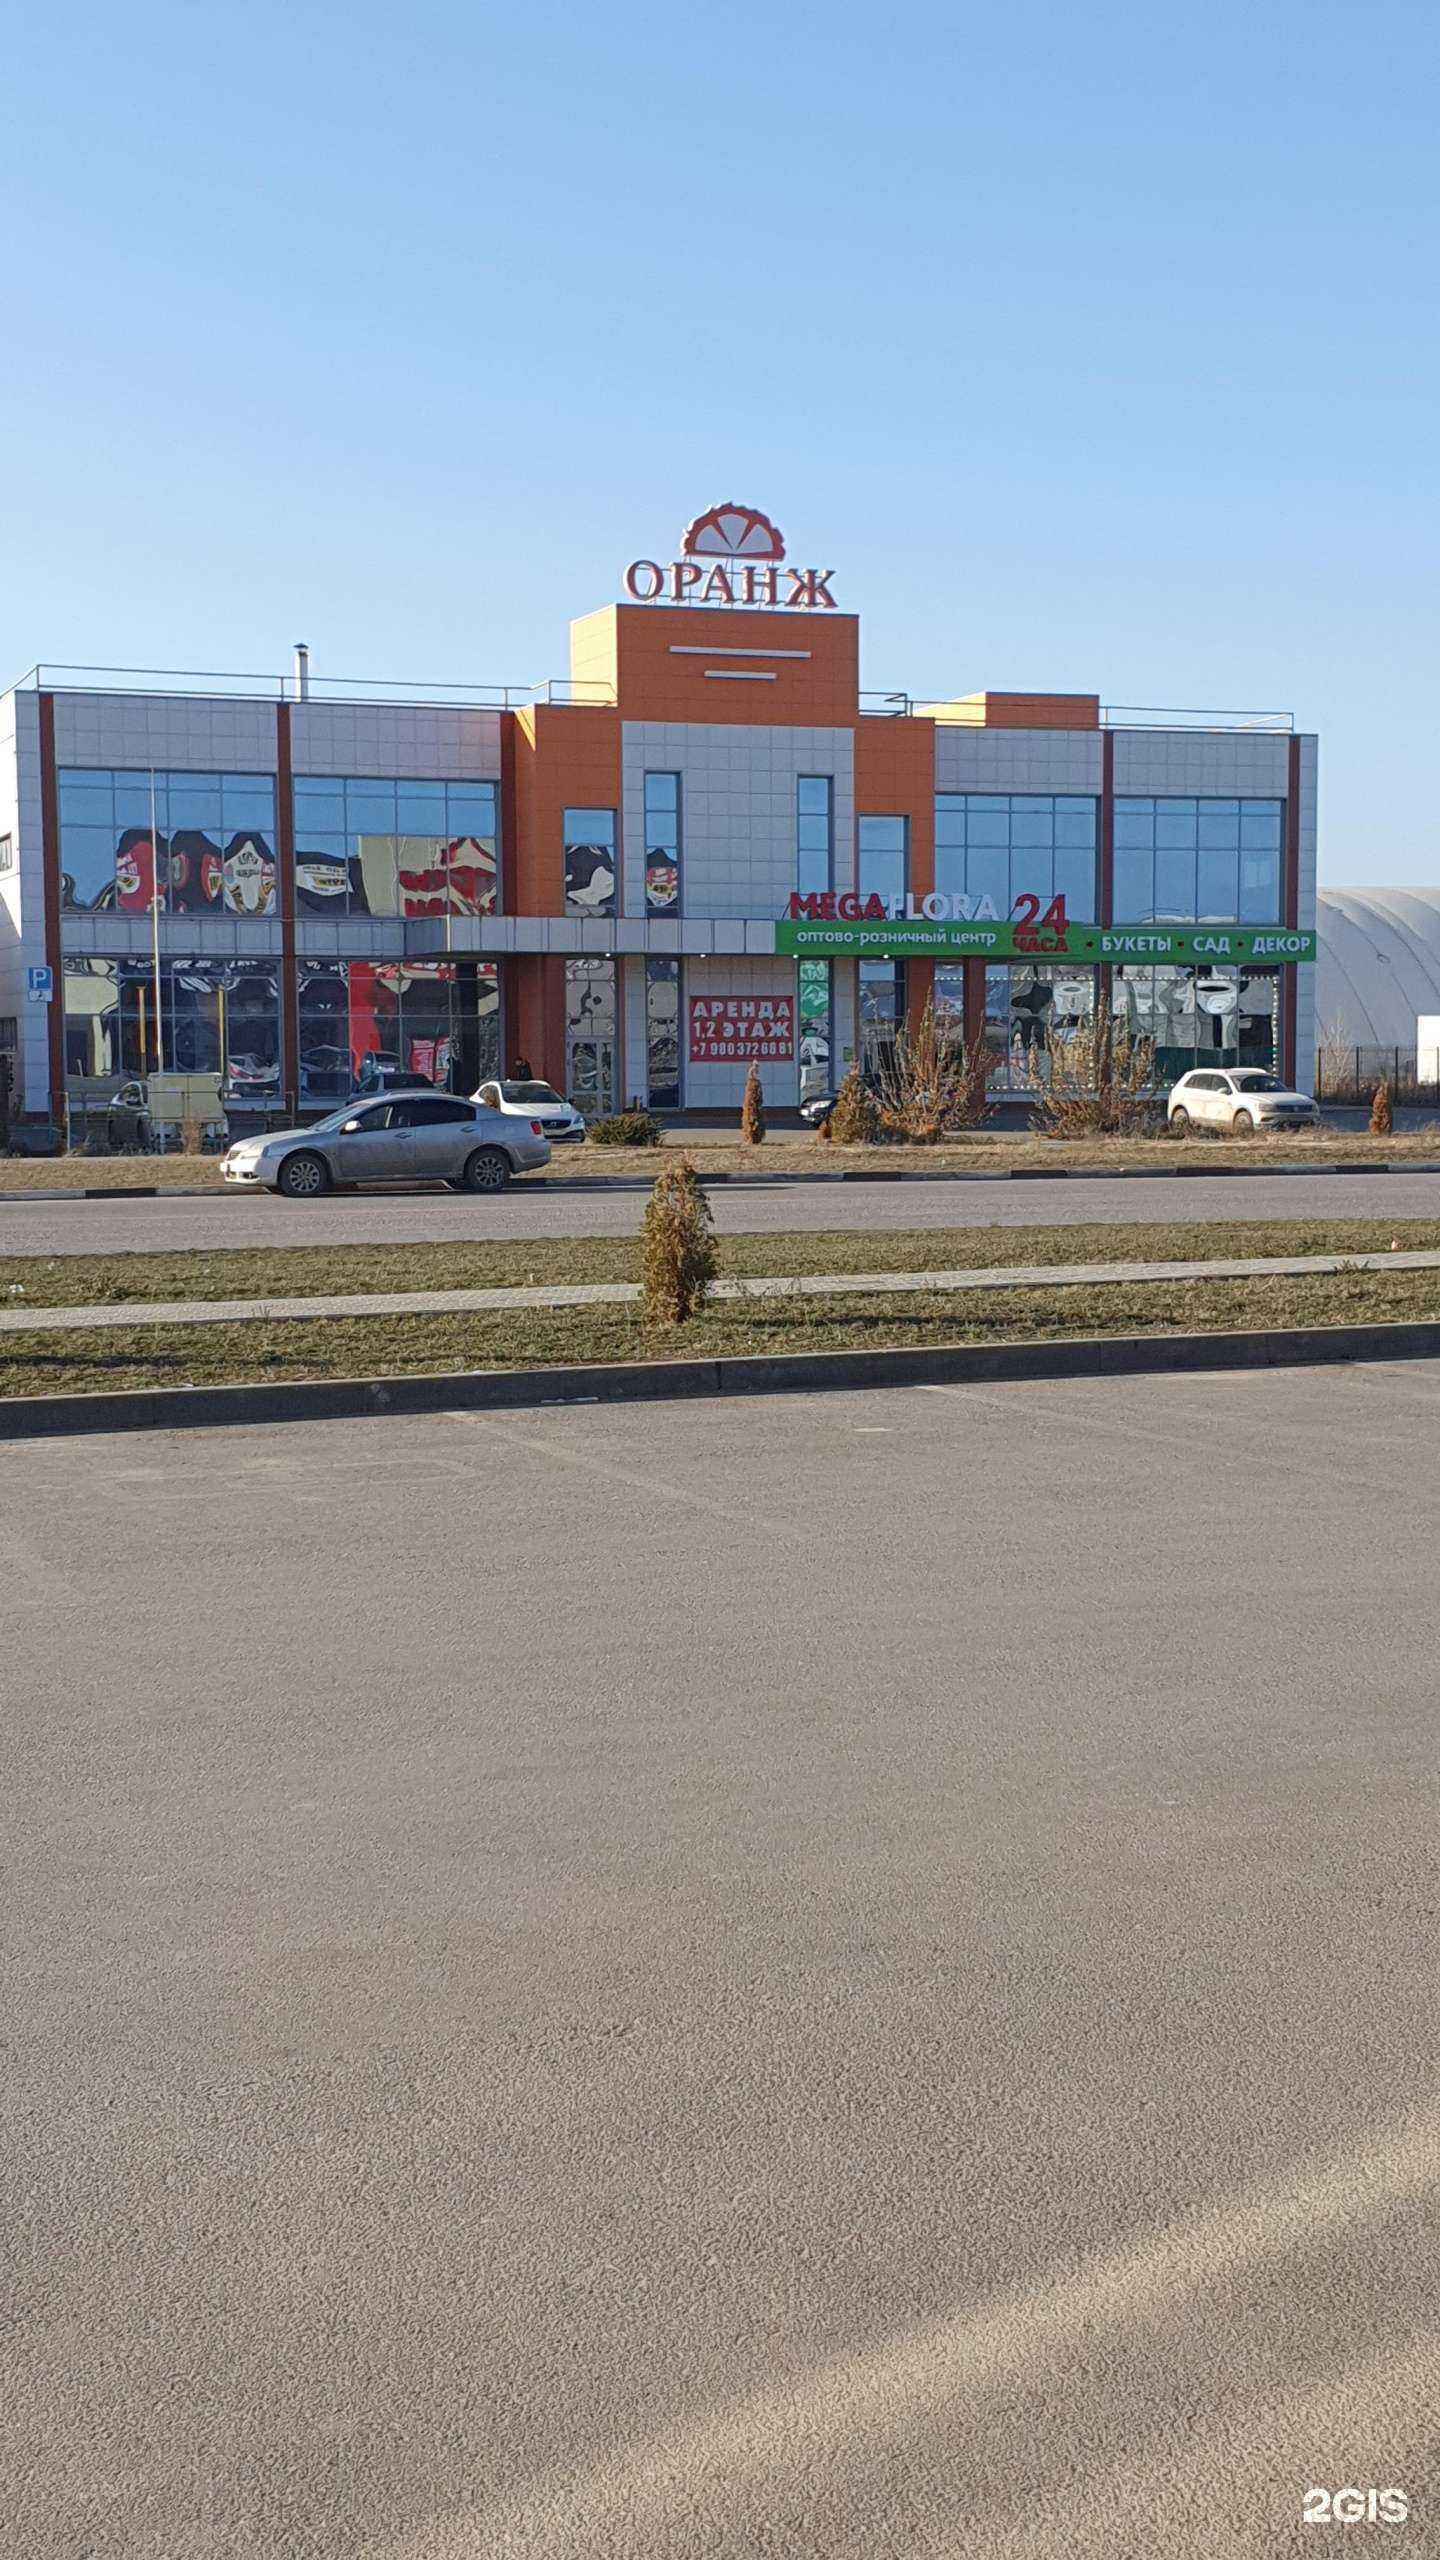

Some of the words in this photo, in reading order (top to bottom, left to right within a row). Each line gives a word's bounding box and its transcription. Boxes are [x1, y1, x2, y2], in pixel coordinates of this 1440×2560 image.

[624, 560, 838, 607] ОРАНЖ
[1014, 893, 1070, 935] 24
[797, 928, 948, 946] оптово-розничный
[951, 930, 997, 946] центр
[1012, 935, 1070, 953] ЧАСА
[1102, 936, 1172, 952] БУКЕТЫ
[1193, 937, 1231, 954] САД
[1252, 937, 1311, 955] ДЕКОР
[693, 1001, 790, 1020] АРЕНДА
[722, 1021, 790, 1038] ЭТАЖ
